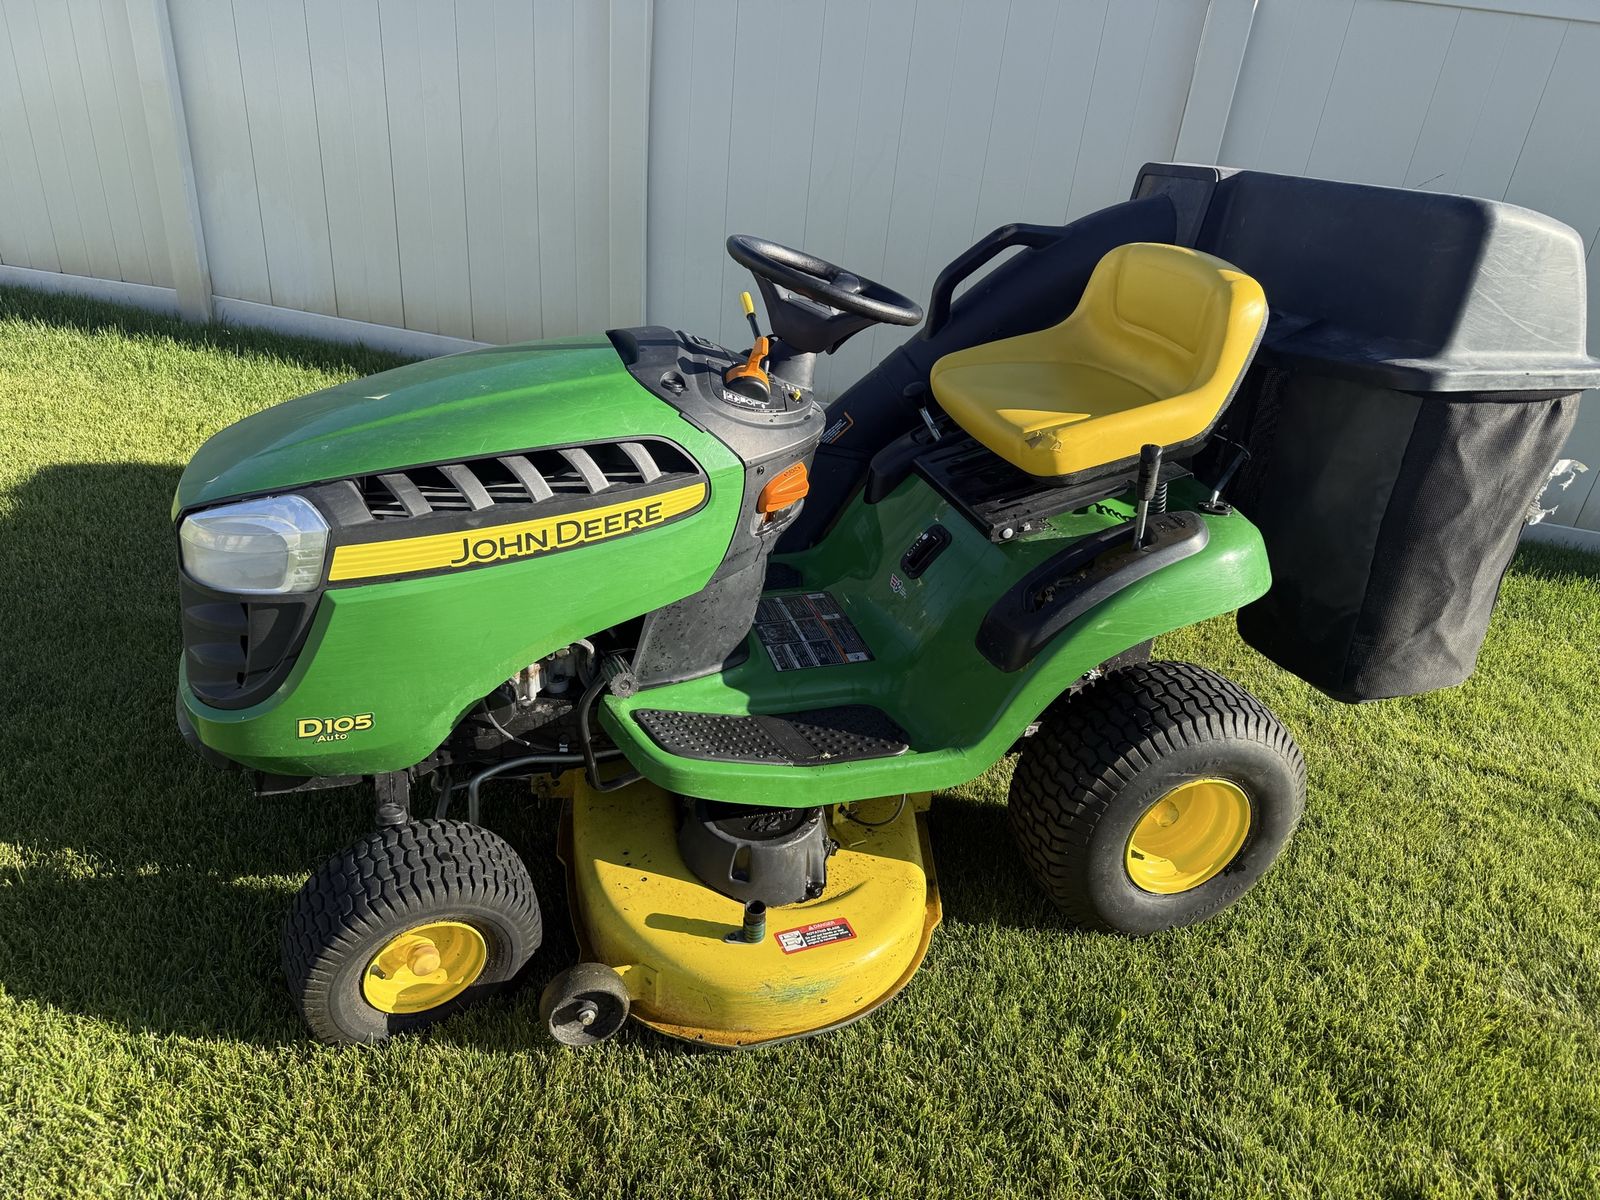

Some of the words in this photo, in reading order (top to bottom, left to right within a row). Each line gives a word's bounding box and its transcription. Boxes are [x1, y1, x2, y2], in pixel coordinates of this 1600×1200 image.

[451, 529, 548, 564] JOHN
[556, 502, 663, 545] DEERE
[297, 713, 373, 738] D105
[316, 733, 348, 743] Auto
